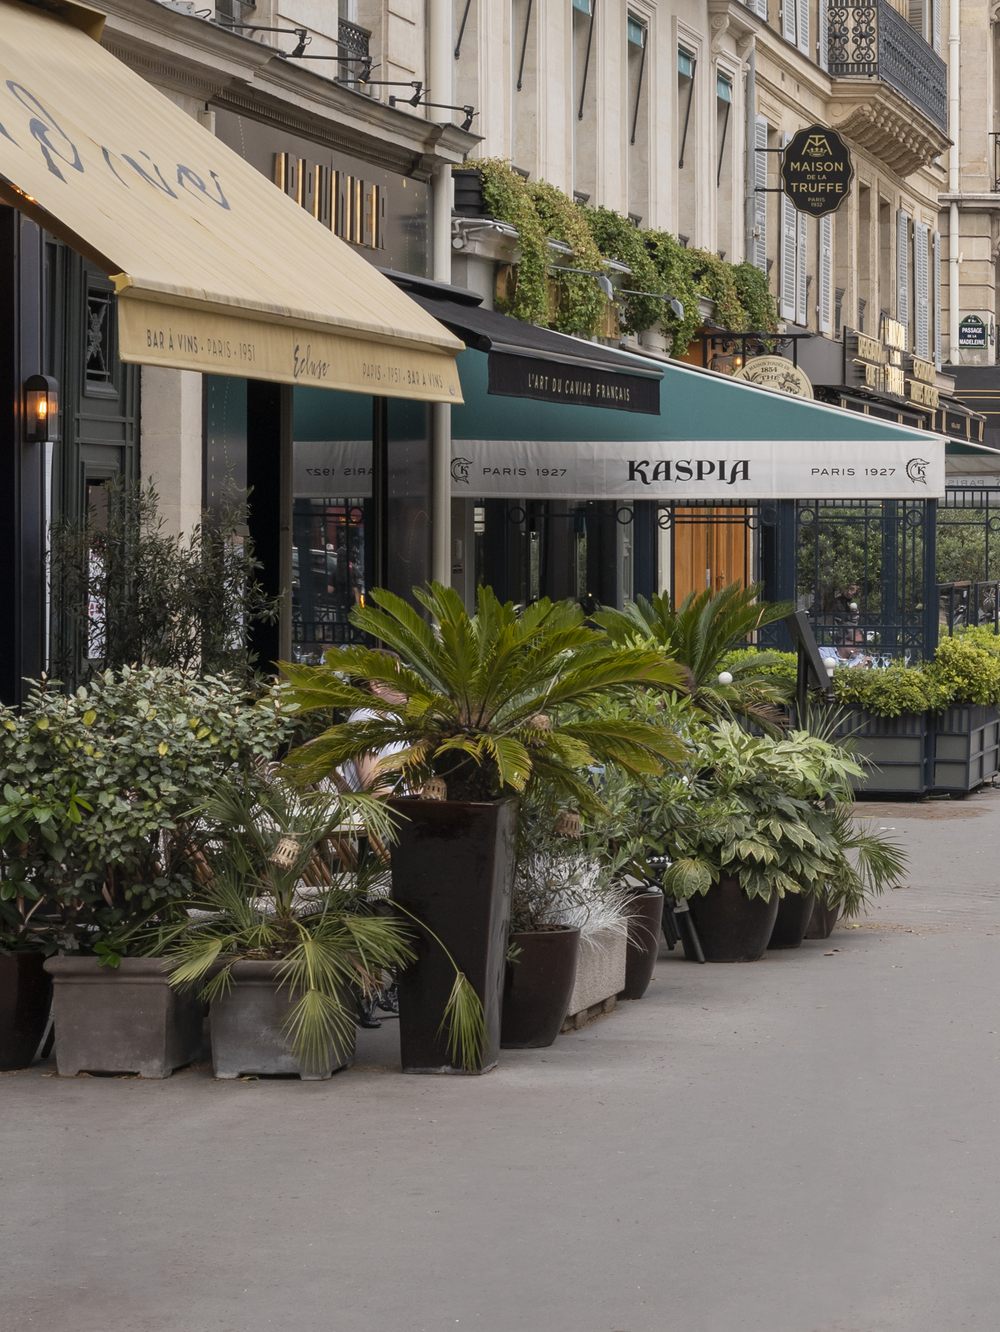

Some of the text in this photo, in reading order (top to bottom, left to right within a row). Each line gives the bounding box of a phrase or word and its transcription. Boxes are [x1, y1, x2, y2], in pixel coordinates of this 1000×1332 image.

[790, 162, 844, 172] MAISON
[790, 183, 843, 193] TRUFFE
[147, 328, 256, 361] BAR À VINS PARIS 1951
[362, 363, 443, 388] PARIS 1951 BAR À VINS
[528, 373, 630, 402] L'ART DU CAVIAR FRANÇAIS
[482, 467, 568, 477] PARIS 1927
[626, 459, 752, 486] KASPIA
[811, 468, 897, 476] PARIS 1927
